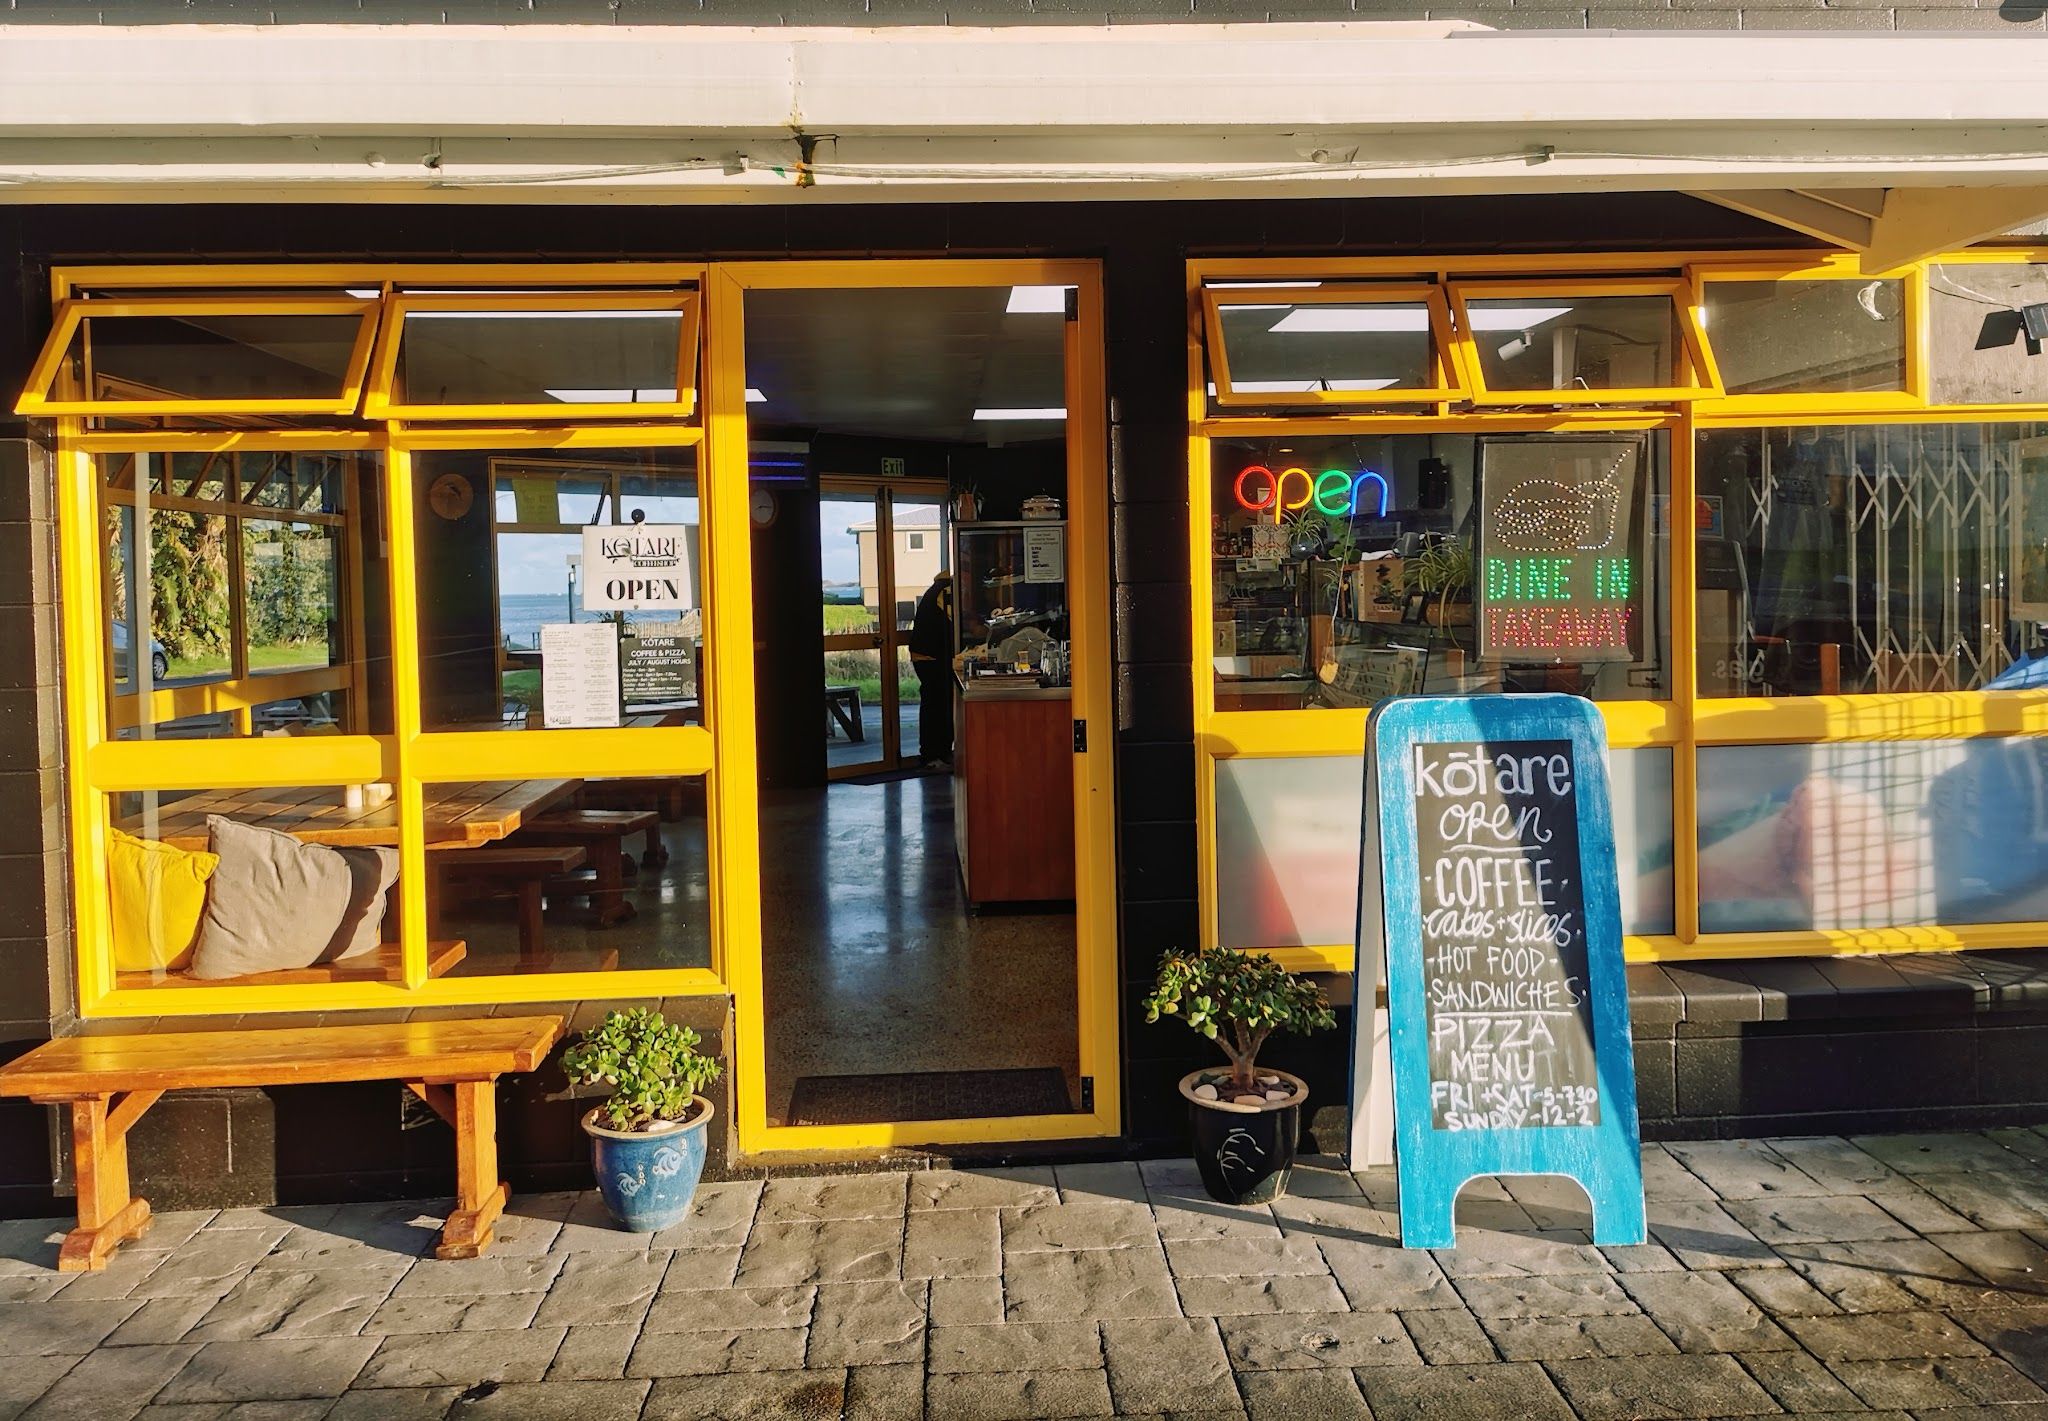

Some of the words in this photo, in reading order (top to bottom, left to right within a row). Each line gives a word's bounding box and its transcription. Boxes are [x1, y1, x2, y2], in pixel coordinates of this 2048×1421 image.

[1234, 465, 1389, 524] open
[606, 579, 680, 601] OPEN
[1488, 558, 1572, 600] DINE
[1595, 558, 1631, 600] IN
[1487, 607, 1633, 648] TAKEAWAY
[665, 648, 686, 657] PIZZA
[1440, 801, 1553, 843] open
[1435, 857, 1556, 908] COFFEE
[1431, 976, 1582, 1011] SANDWICHES
[1431, 1014, 1555, 1050] PIZZA
[1451, 1049, 1536, 1082] MENU
[1431, 1080, 1474, 1111] FRI
[1444, 1107, 1529, 1132] SUNDAY
